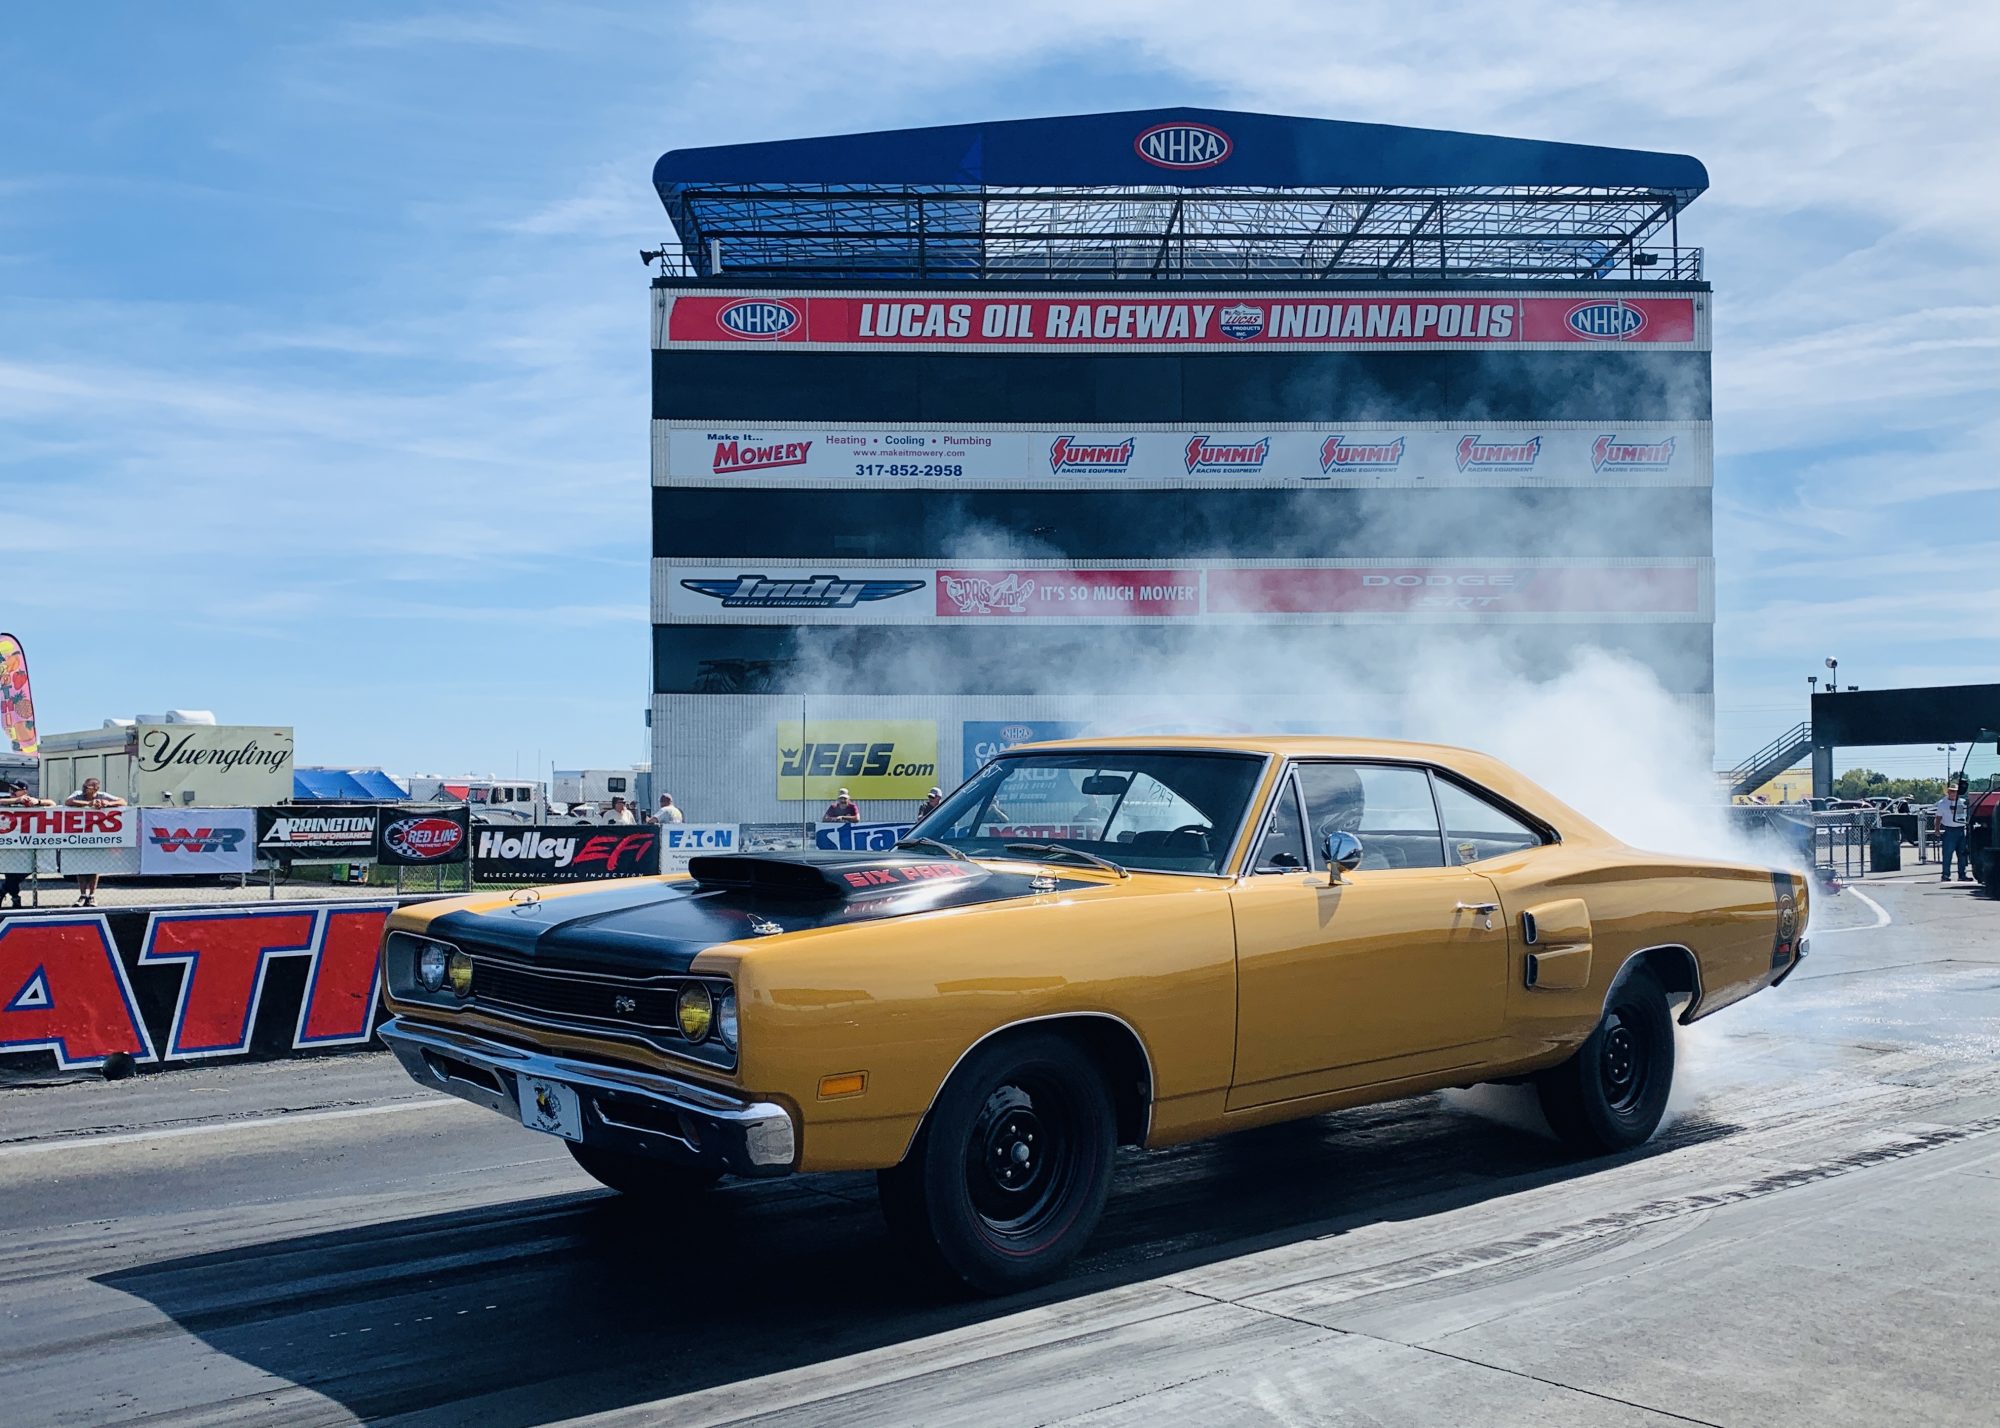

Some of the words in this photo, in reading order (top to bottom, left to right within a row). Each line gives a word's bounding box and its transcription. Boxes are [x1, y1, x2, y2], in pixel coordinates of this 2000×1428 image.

[1149, 130, 1219, 162] NHRA
[729, 302, 796, 333] NHRA
[858, 303, 971, 338] LUCAS
[981, 303, 1034, 338] OIL
[1045, 303, 1215, 338] RACEWAY
[1225, 315, 1261, 324] LUCAS
[1267, 304, 1514, 339] INDIANAPOLIS
[1577, 302, 1639, 336] NHRA
[707, 433, 739, 441] Make
[825, 435, 867, 446] Heating
[885, 435, 925, 448] Cooling
[943, 435, 992, 448] Plumbing
[712, 440, 813, 468] MOWERY
[853, 449, 966, 459] www.makeitmowery.com
[855, 464, 963, 477] 317-852-2958
[730, 578, 867, 604] Indy
[1040, 585, 1066, 601] IT'S
[1070, 585, 1088, 601] SO
[1093, 585, 1134, 601] MUCH
[1139, 585, 1195, 601] MOWER
[1361, 575, 1515, 587] DODGE
[1004, 727, 1030, 739] NHRA
[138, 730, 293, 773] Yuengling
[780, 742, 935, 777] JEGS.com
[19, 836, 62, 845] Waxes
[68, 835, 122, 845] Cleaners
[149, 828, 246, 852] WR
[262, 817, 376, 841] ARRINGTON
[308, 832, 373, 841] PERFORMANCE
[407, 830, 431, 844] RED
[434, 826, 459, 843] LINE
[669, 830, 732, 848] EATON
[477, 831, 576, 868] Holley
[843, 869, 900, 888] SIX
[900, 864, 969, 881] PACK
